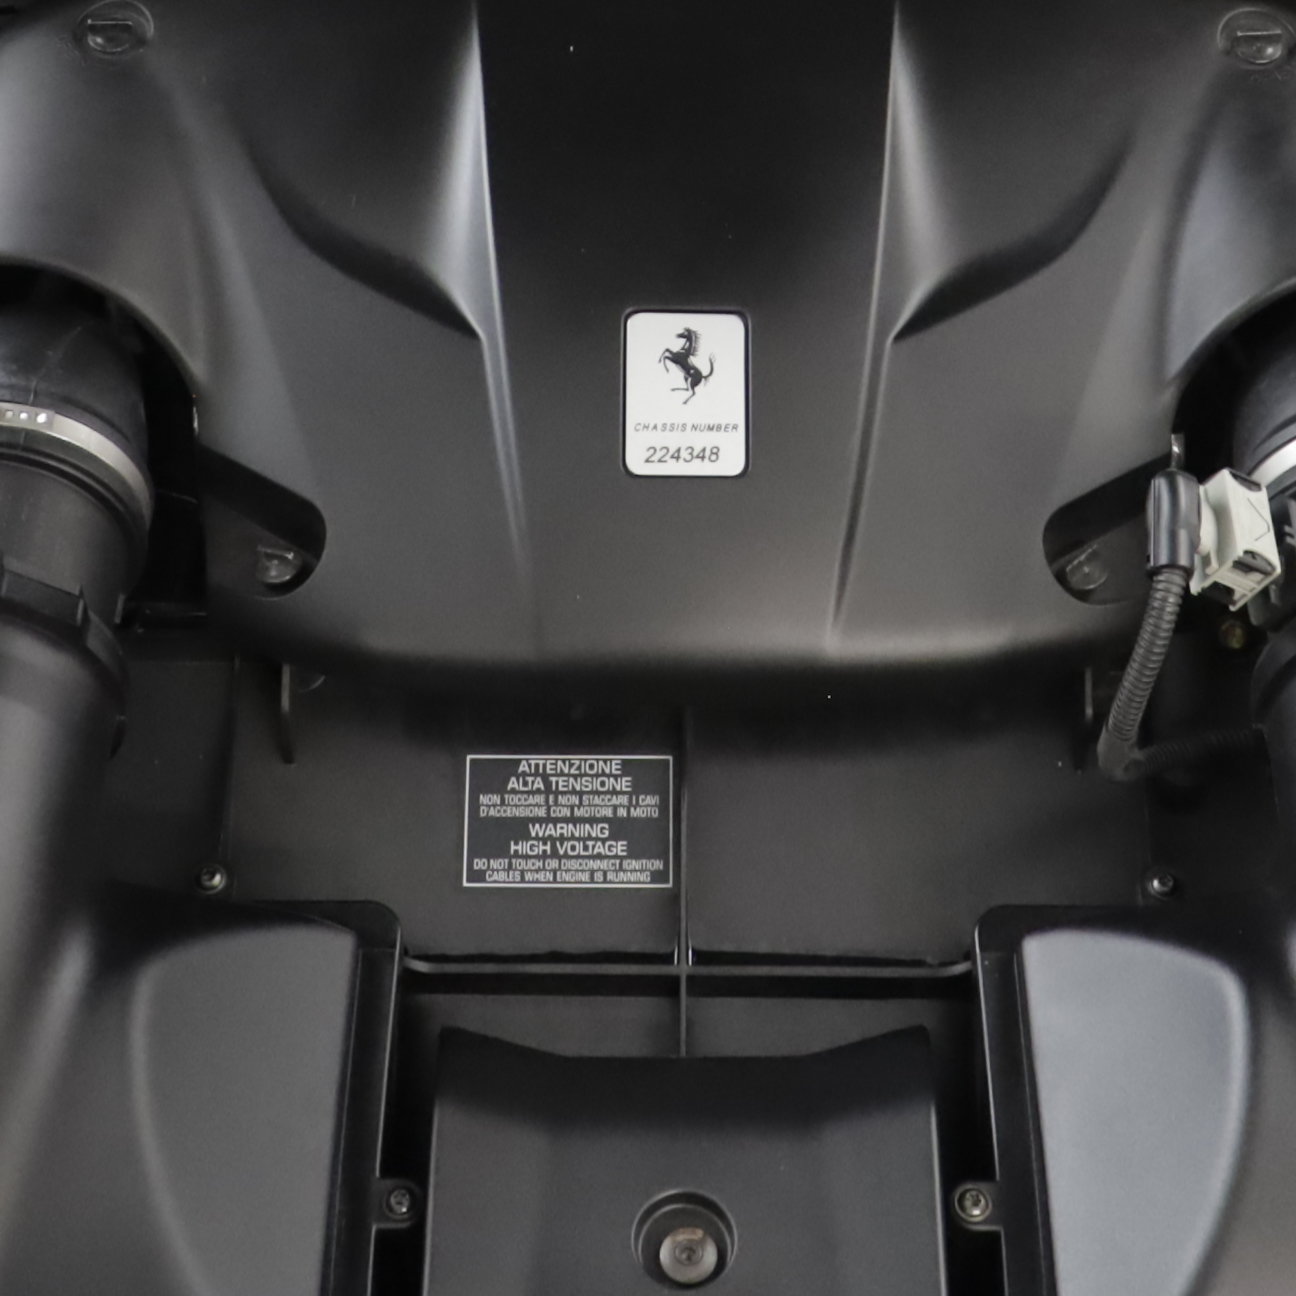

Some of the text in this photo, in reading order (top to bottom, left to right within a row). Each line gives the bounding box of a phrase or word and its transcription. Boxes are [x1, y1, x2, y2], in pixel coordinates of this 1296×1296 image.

[634, 422, 739, 432] CHASSIS NUMBER
[644, 446, 720, 463] 224348
[517, 760, 622, 774] ATTENZIONE
[507, 777, 632, 791] ALTA TENSIONE
[480, 794, 500, 805] NON
[504, 794, 545, 805] TOCCARE
[549, 794, 554, 805] E
[558, 794, 579, 805] NON
[582, 794, 629, 805] STACCARE
[639, 794, 659, 805] CAVI
[480, 806, 658, 817] D'ACCENSIONE CON MOTORE IN MOTO
[529, 823, 609, 838] WARNING
[510, 841, 628, 855] HIGH VOLTAGE
[474, 859, 664, 870] DO NOT TOUCH OR DISCONNECT IGNITION
[486, 871, 650, 882] CABLES WHEN ENGINE IS RUNNING
